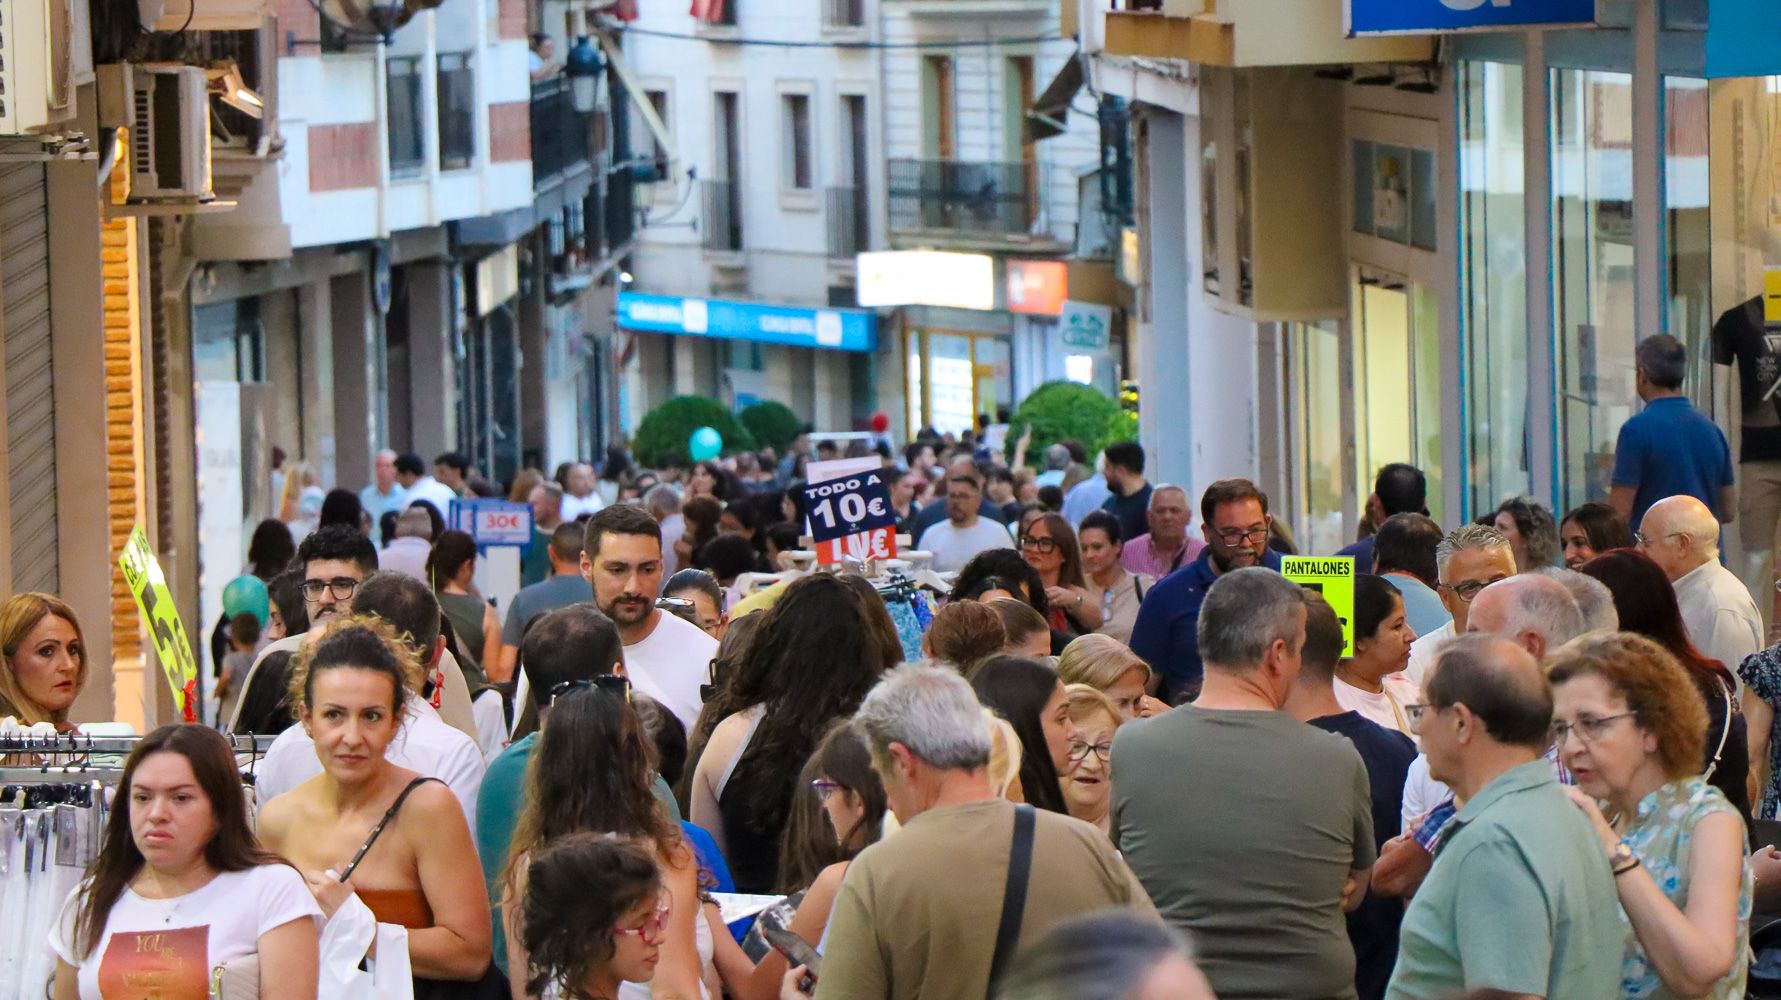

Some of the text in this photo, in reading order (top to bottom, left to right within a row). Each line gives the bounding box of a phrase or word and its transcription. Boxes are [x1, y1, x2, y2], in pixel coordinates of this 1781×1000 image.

[805, 474, 882, 499] TODO A
[813, 493, 887, 528] 10€
[486, 513, 519, 529] 30€
[1285, 561, 1350, 575] PANTALONES
[135, 934, 166, 953] YOU
